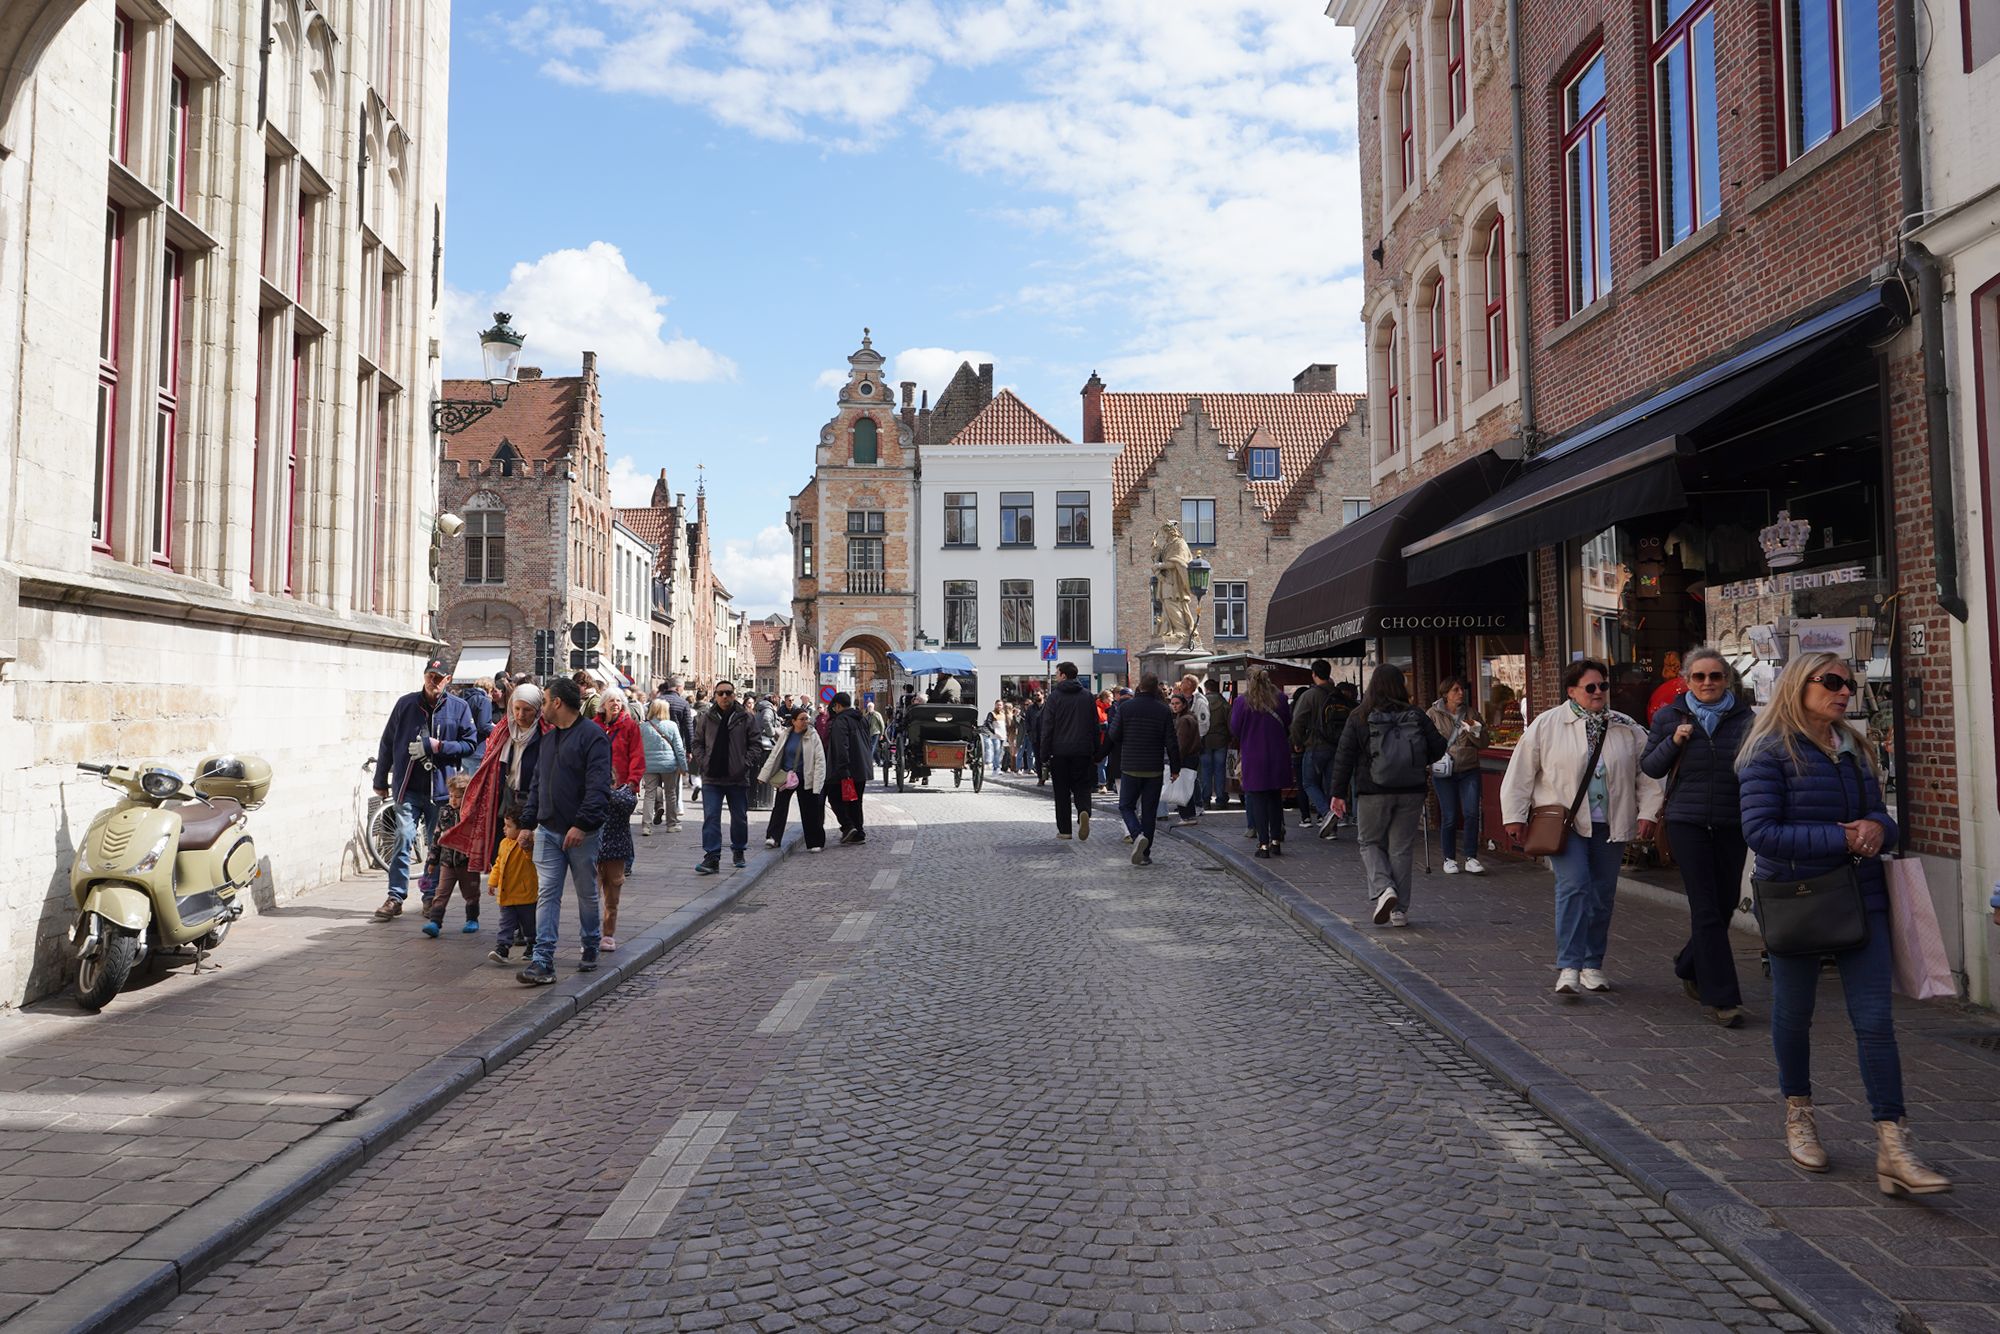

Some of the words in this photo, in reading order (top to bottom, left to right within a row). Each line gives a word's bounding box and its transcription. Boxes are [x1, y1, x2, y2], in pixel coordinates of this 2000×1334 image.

[1722, 580, 1778, 599] BELGN
[1783, 567, 1866, 592] HERITAGE
[1280, 636, 1297, 652] BELGIAN
[1297, 628, 1325, 649] CHOCOLATES
[1329, 616, 1365, 642] CHOCOHOLIC
[1380, 615, 1506, 630] CHOCOHOLIC
[1911, 630, 1924, 649] 32
